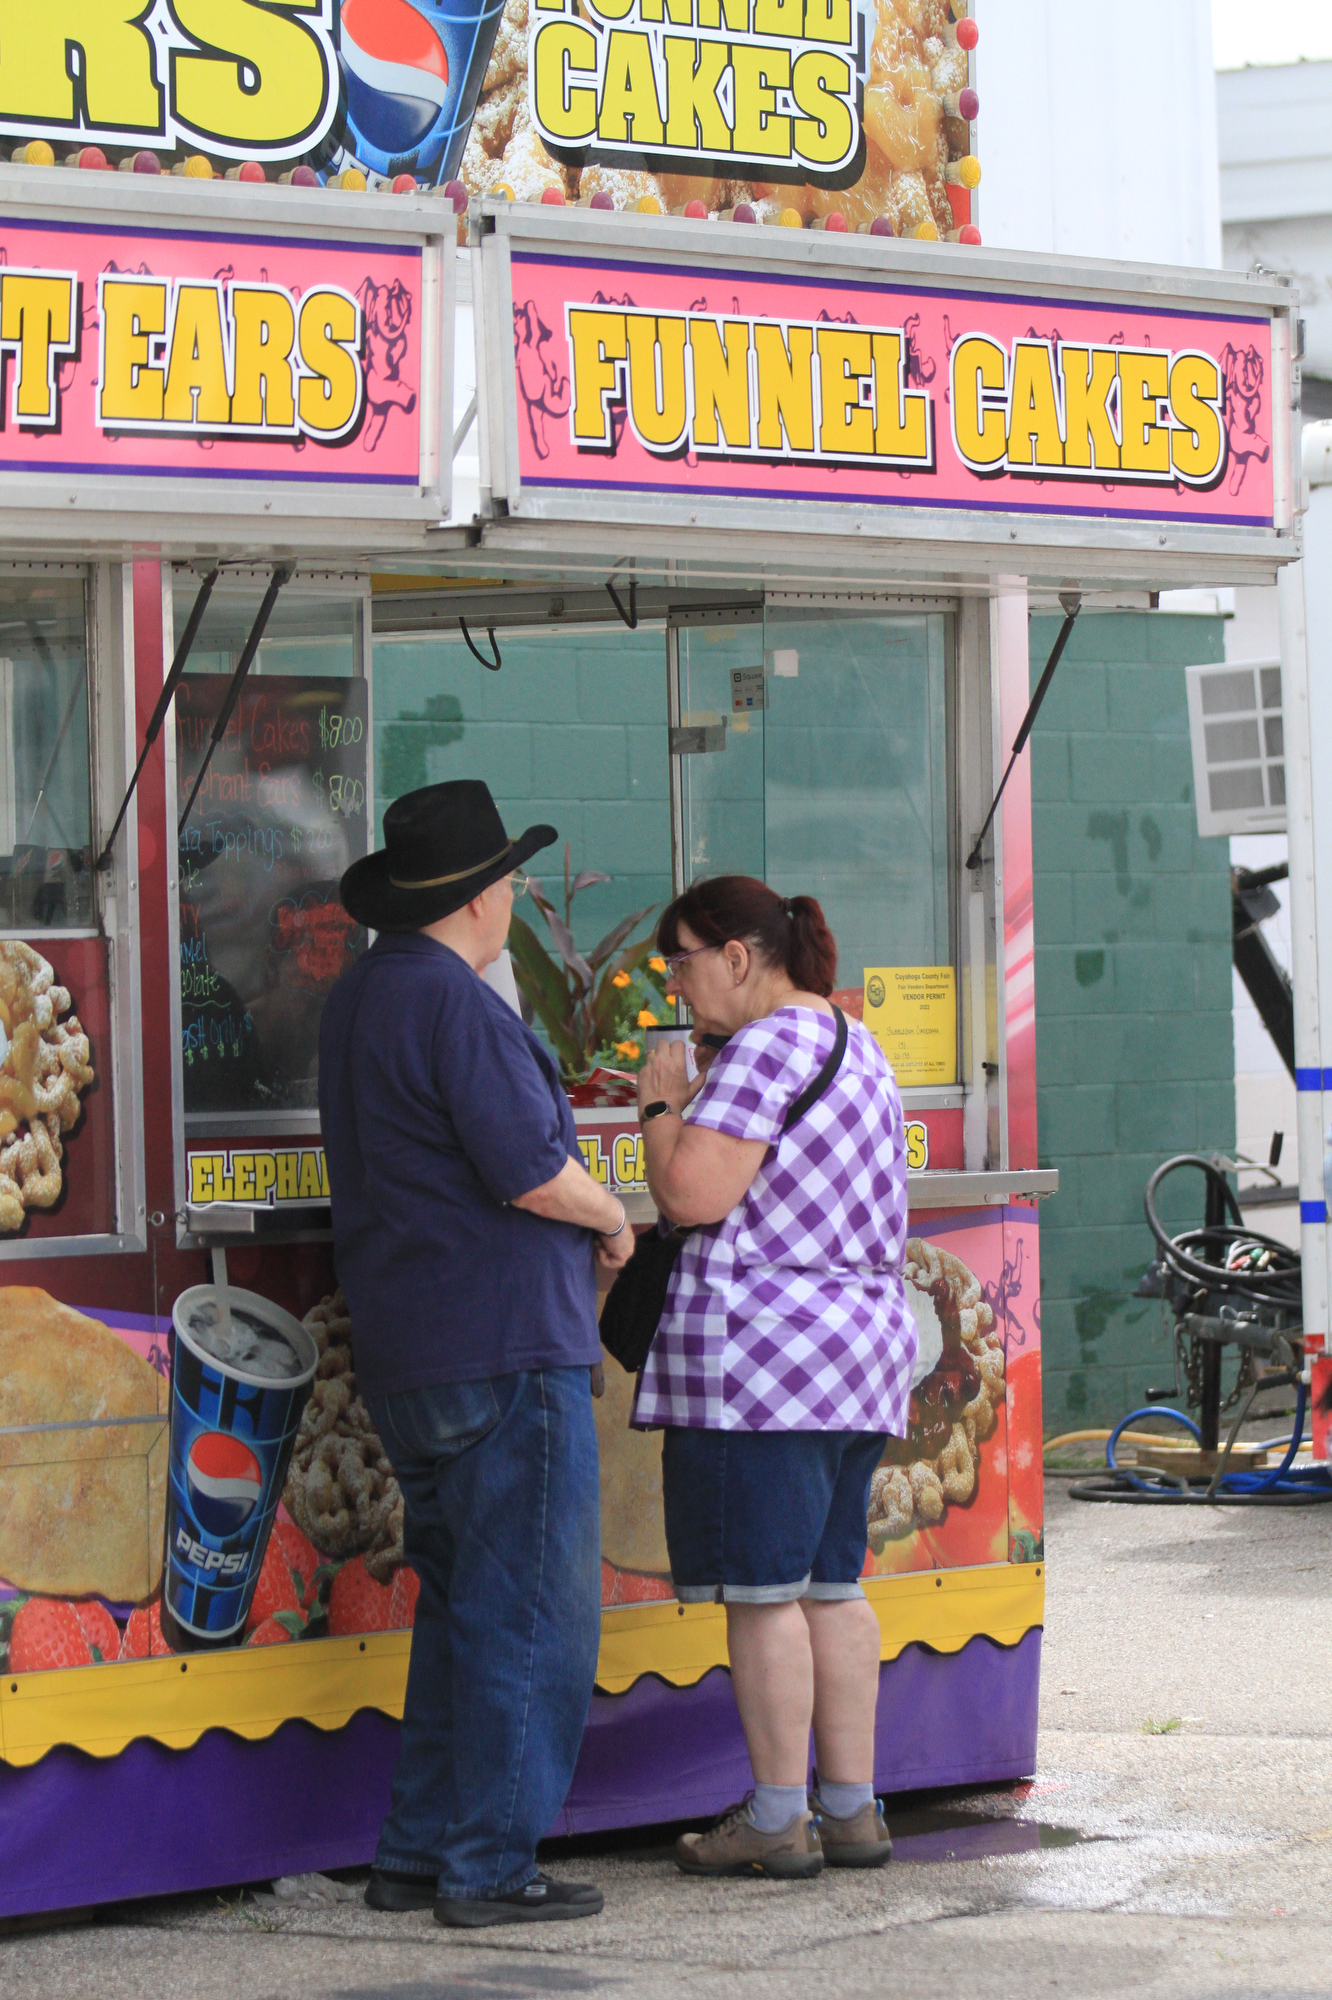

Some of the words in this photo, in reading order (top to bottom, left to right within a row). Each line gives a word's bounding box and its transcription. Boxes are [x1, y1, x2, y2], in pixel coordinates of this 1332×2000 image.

[532, 18, 856, 167] CAKES
[98, 276, 360, 435] EARS
[567, 306, 930, 462] FUNNEL
[951, 335, 1223, 480] CAKES
[251, 694, 311, 755] Cakes
[258, 762, 301, 807] Ears
[206, 820, 284, 871] Toppings
[895, 973, 920, 981] Cuyahoga
[175, 1526, 250, 1574] PEPSI
